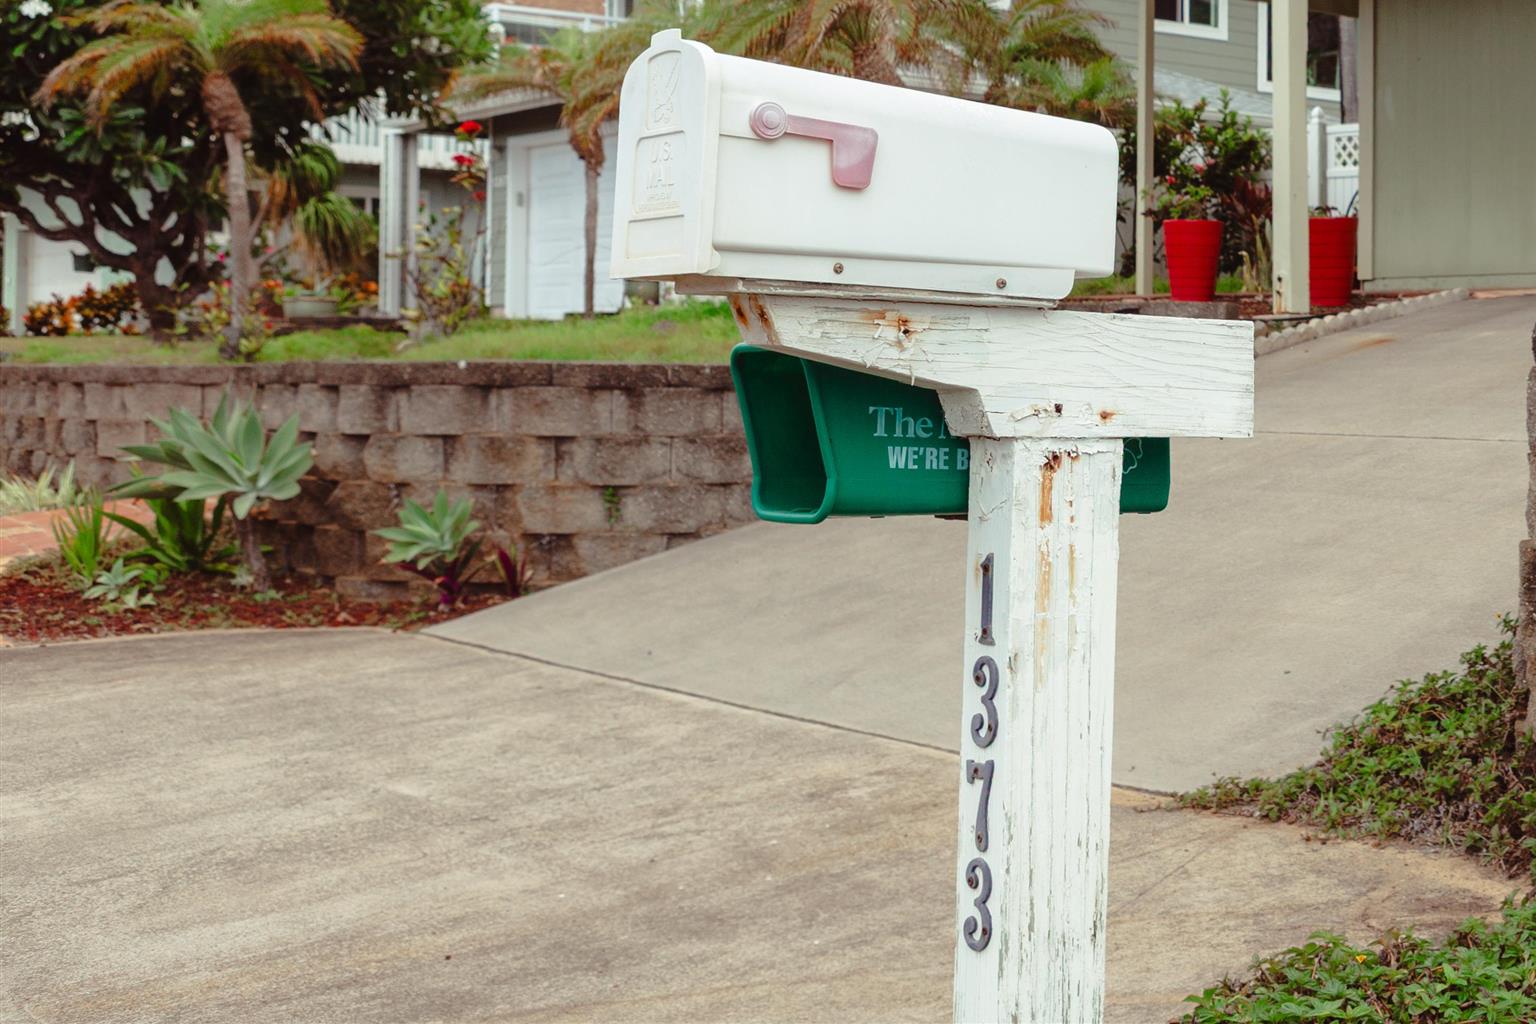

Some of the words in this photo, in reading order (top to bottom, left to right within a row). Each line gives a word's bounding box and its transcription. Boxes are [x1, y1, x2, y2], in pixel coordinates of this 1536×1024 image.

[868, 406, 933, 438] The
[887, 446, 949, 469] WE'RE
[963, 552, 999, 952] 1373
